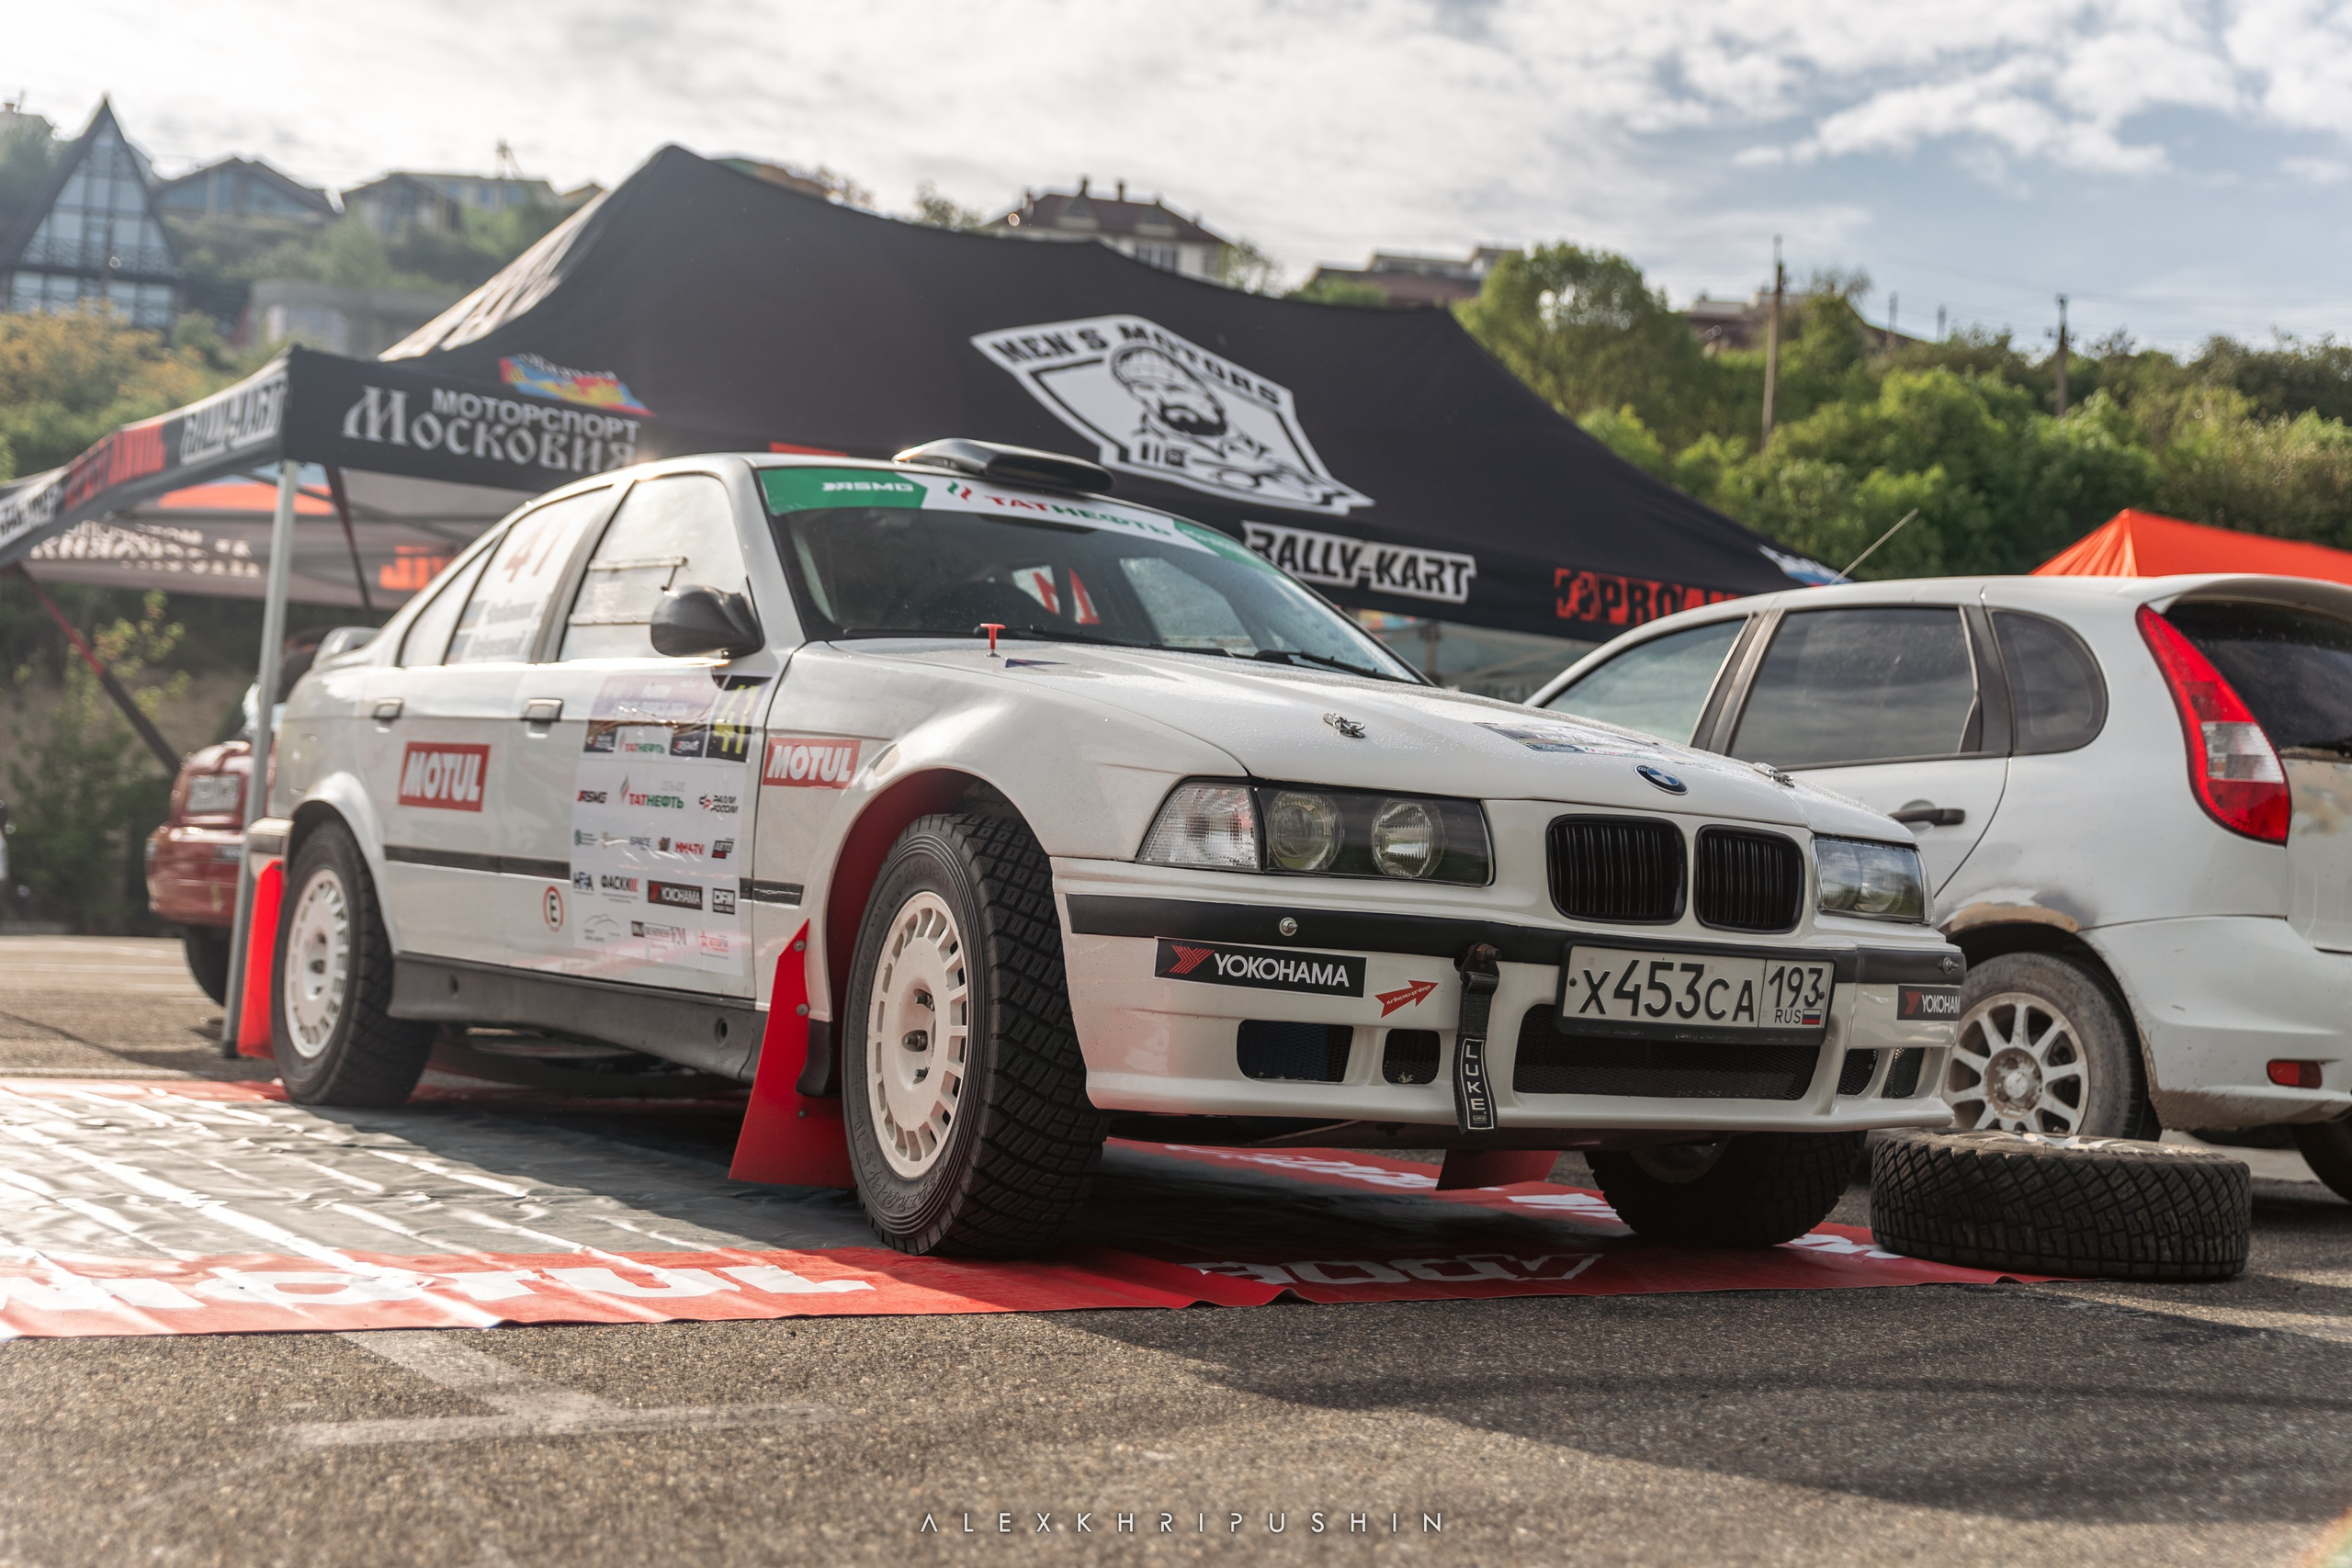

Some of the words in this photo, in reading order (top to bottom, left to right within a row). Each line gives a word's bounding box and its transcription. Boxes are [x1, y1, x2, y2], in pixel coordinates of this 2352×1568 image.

[992, 327, 1108, 363] MEN'S
[1116, 323, 1281, 405] MOTORS
[432, 387, 642, 443] МОТОРСПОРТ
[984, 494, 1172, 537] ТАТНЕФТЬ
[1248, 528, 1471, 597] RALLY-KART
[401, 750, 482, 803] MOTUL
[765, 744, 854, 783] MOTUL
[629, 793, 684, 809] ТАТНЕФТЬ
[661, 886, 702, 906] YOKOHAMA
[1214, 953, 1350, 987] YOKOHAMA
[1768, 964, 1823, 1009] 193
[1773, 1008, 1803, 1025] RUS
[1921, 994, 1961, 1014] YOKOHAM
[1464, 1044, 1486, 1111] LUKE
